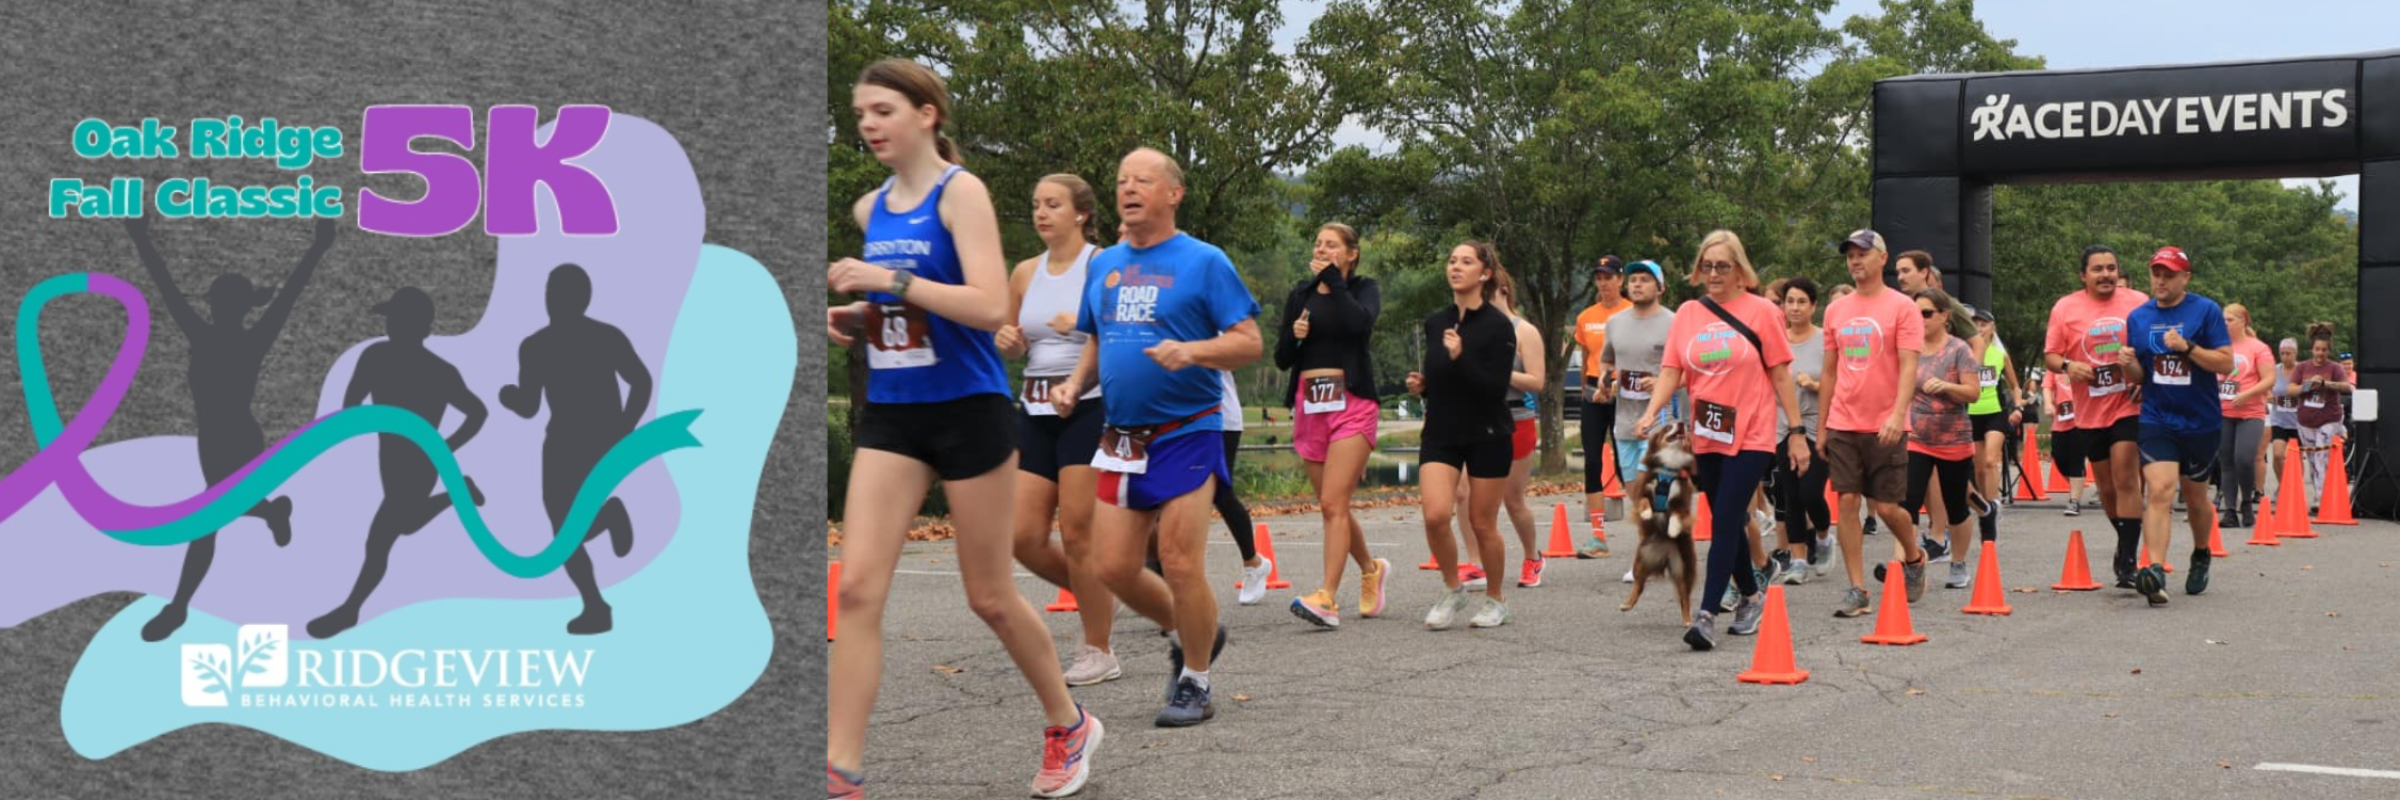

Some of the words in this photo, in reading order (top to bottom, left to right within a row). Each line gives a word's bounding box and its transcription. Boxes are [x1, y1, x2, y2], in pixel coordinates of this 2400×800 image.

[1970, 94, 2084, 141] RACE
[2090, 98, 2172, 137] DAY
[2176, 89, 2349, 133] EVENTS
[73, 118, 179, 158] Oak
[190, 115, 343, 169] Ridge
[357, 104, 620, 237] 5K
[49, 177, 144, 218] Fall
[155, 175, 343, 218] Classic
[1117, 285, 1159, 304] ROAD
[1116, 303, 1157, 322] RACE
[881, 316, 909, 347] 68
[2162, 360, 2183, 375] 194
[2098, 371, 2112, 385] 45
[1031, 379, 1048, 400] 41
[1311, 383, 1335, 402] 177
[1705, 410, 1722, 430] 25
[296, 648, 596, 688] RIDGEVIEW
[241, 693, 378, 708] BEHAVIORAL
[390, 693, 471, 708] HEALTH
[483, 693, 585, 708] SERVICES
